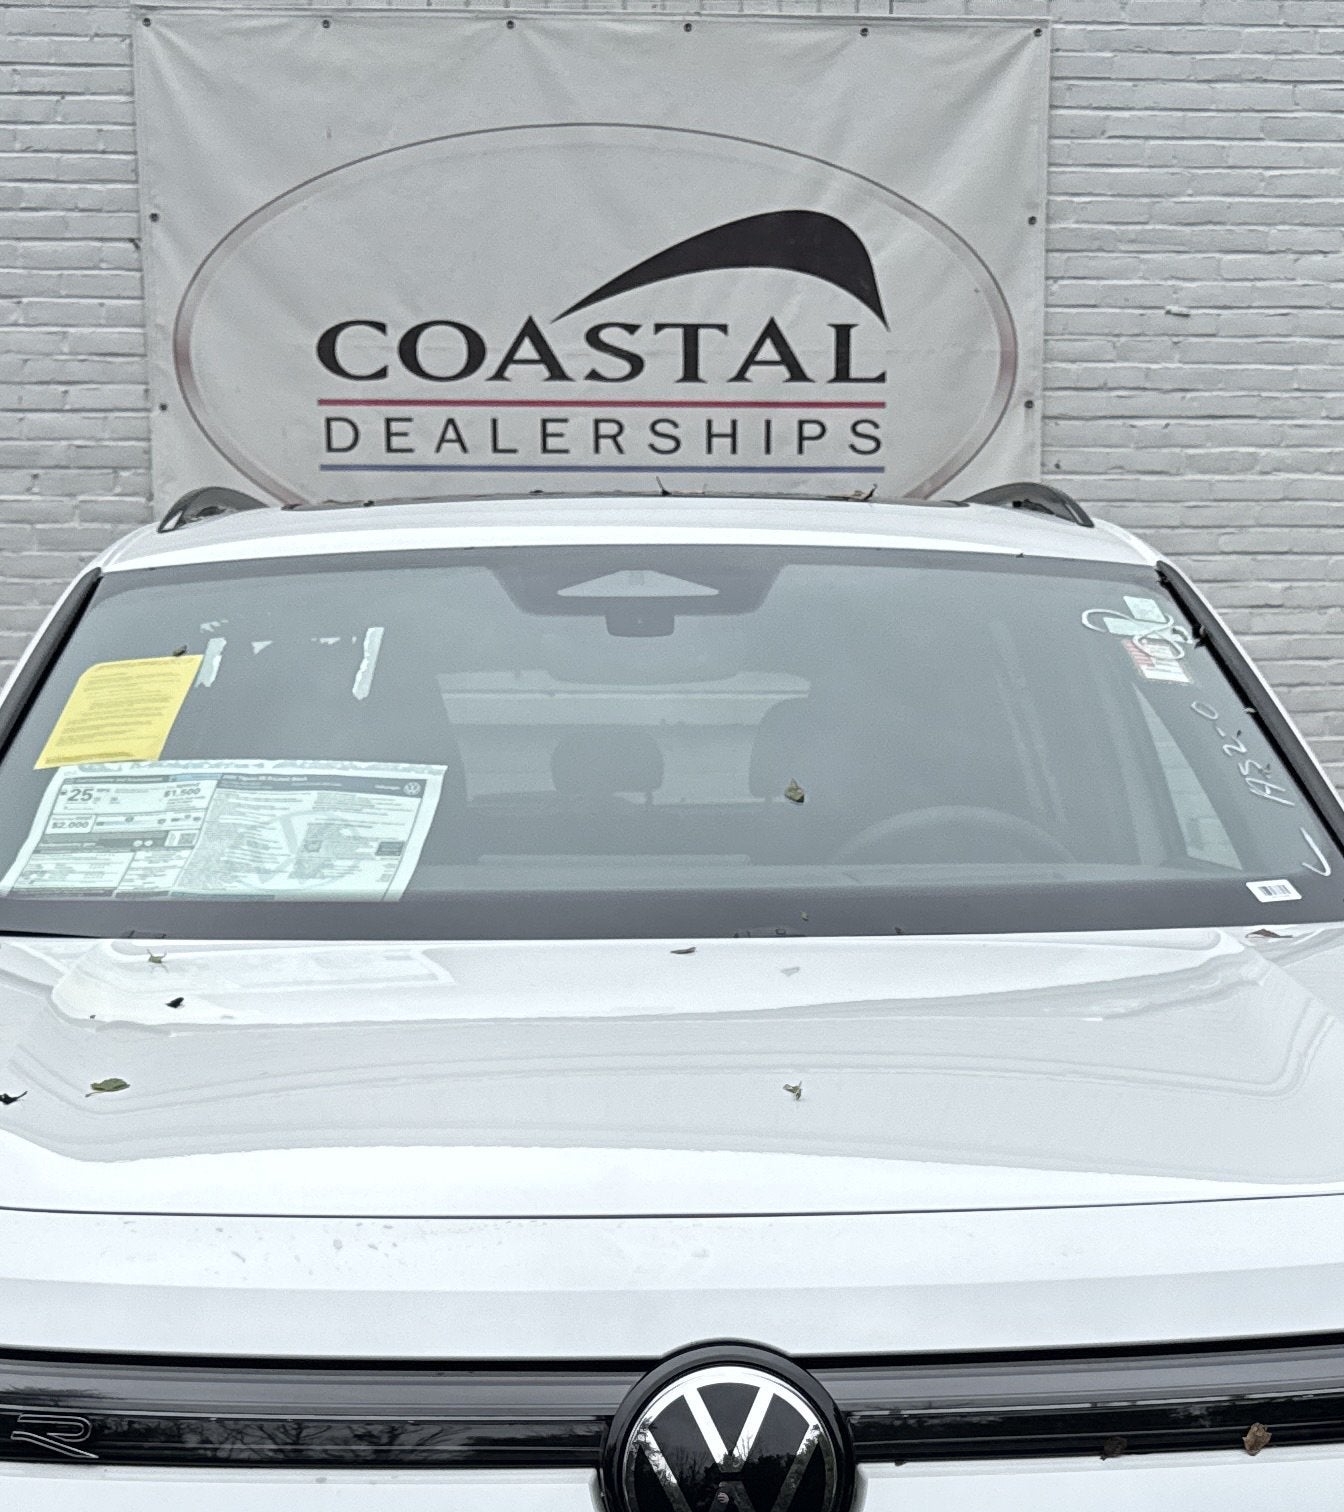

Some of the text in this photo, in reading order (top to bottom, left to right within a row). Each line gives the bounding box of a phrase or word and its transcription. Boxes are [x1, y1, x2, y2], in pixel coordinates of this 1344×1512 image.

[316, 315, 888, 385] COASTAL
[324, 415, 883, 456] DEALERSHIPS
[10, 1413, 100, 1459] R
